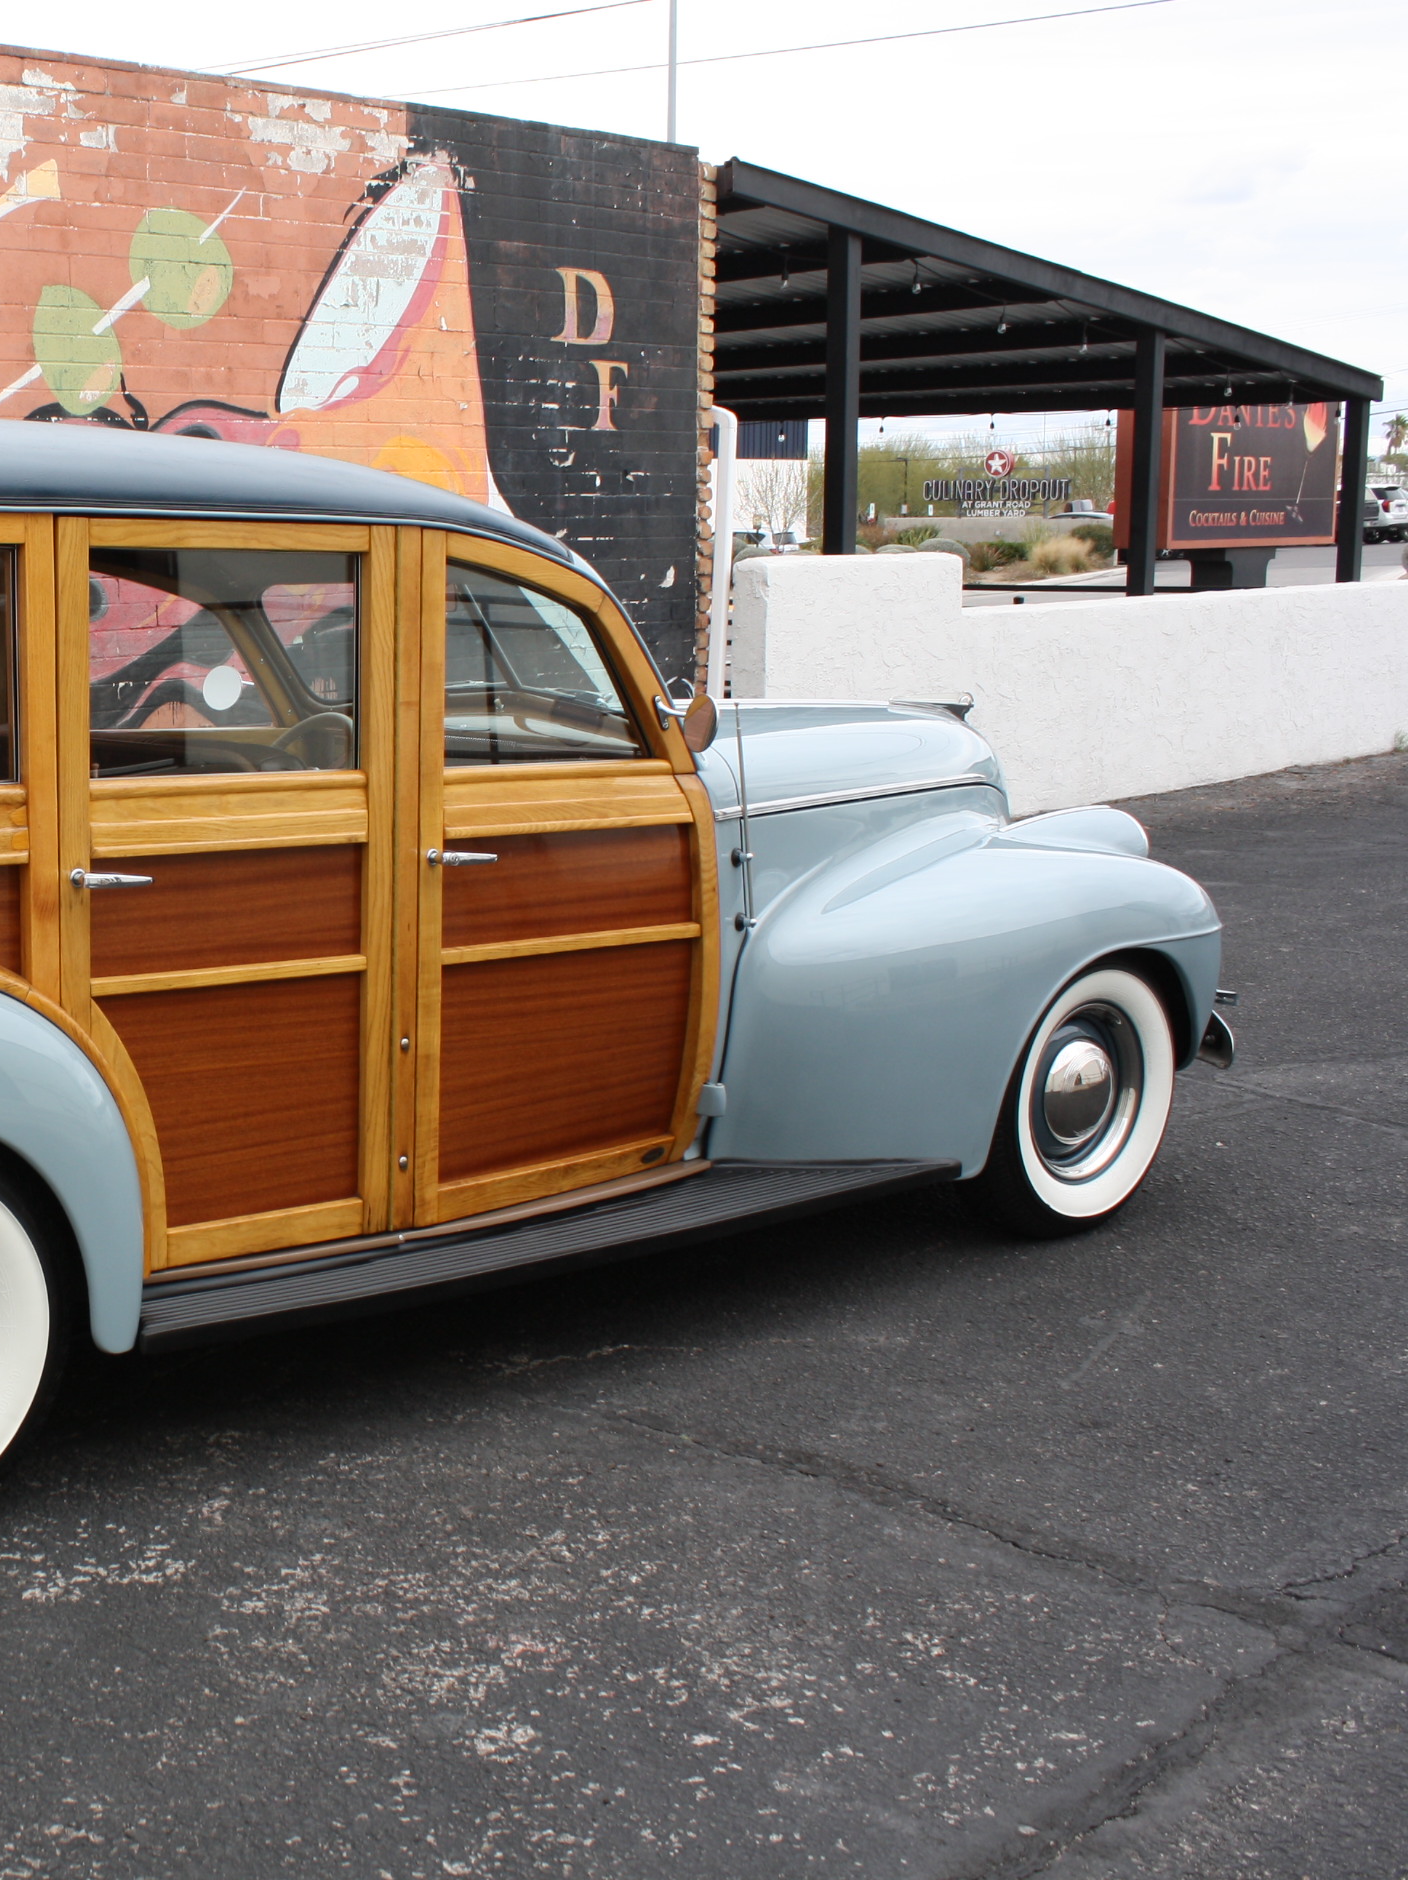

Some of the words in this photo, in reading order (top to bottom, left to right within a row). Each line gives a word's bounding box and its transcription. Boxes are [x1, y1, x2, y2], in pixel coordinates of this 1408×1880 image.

[549, 267, 615, 346] D
[590, 360, 629, 430] F
[1208, 432, 1273, 491] FIRE
[923, 480, 995, 501] CULINARY
[1000, 479, 1070, 501] DROPOUT
[962, 501, 974, 509] AT
[974, 501, 1005, 509] GRANT
[1006, 500, 1031, 509] ROAD
[1003, 509, 1026, 517] YARD
[1189, 510, 1237, 527] COCKTAILS
[1240, 511, 1247, 526] &
[1249, 509, 1286, 526] CUISINE
